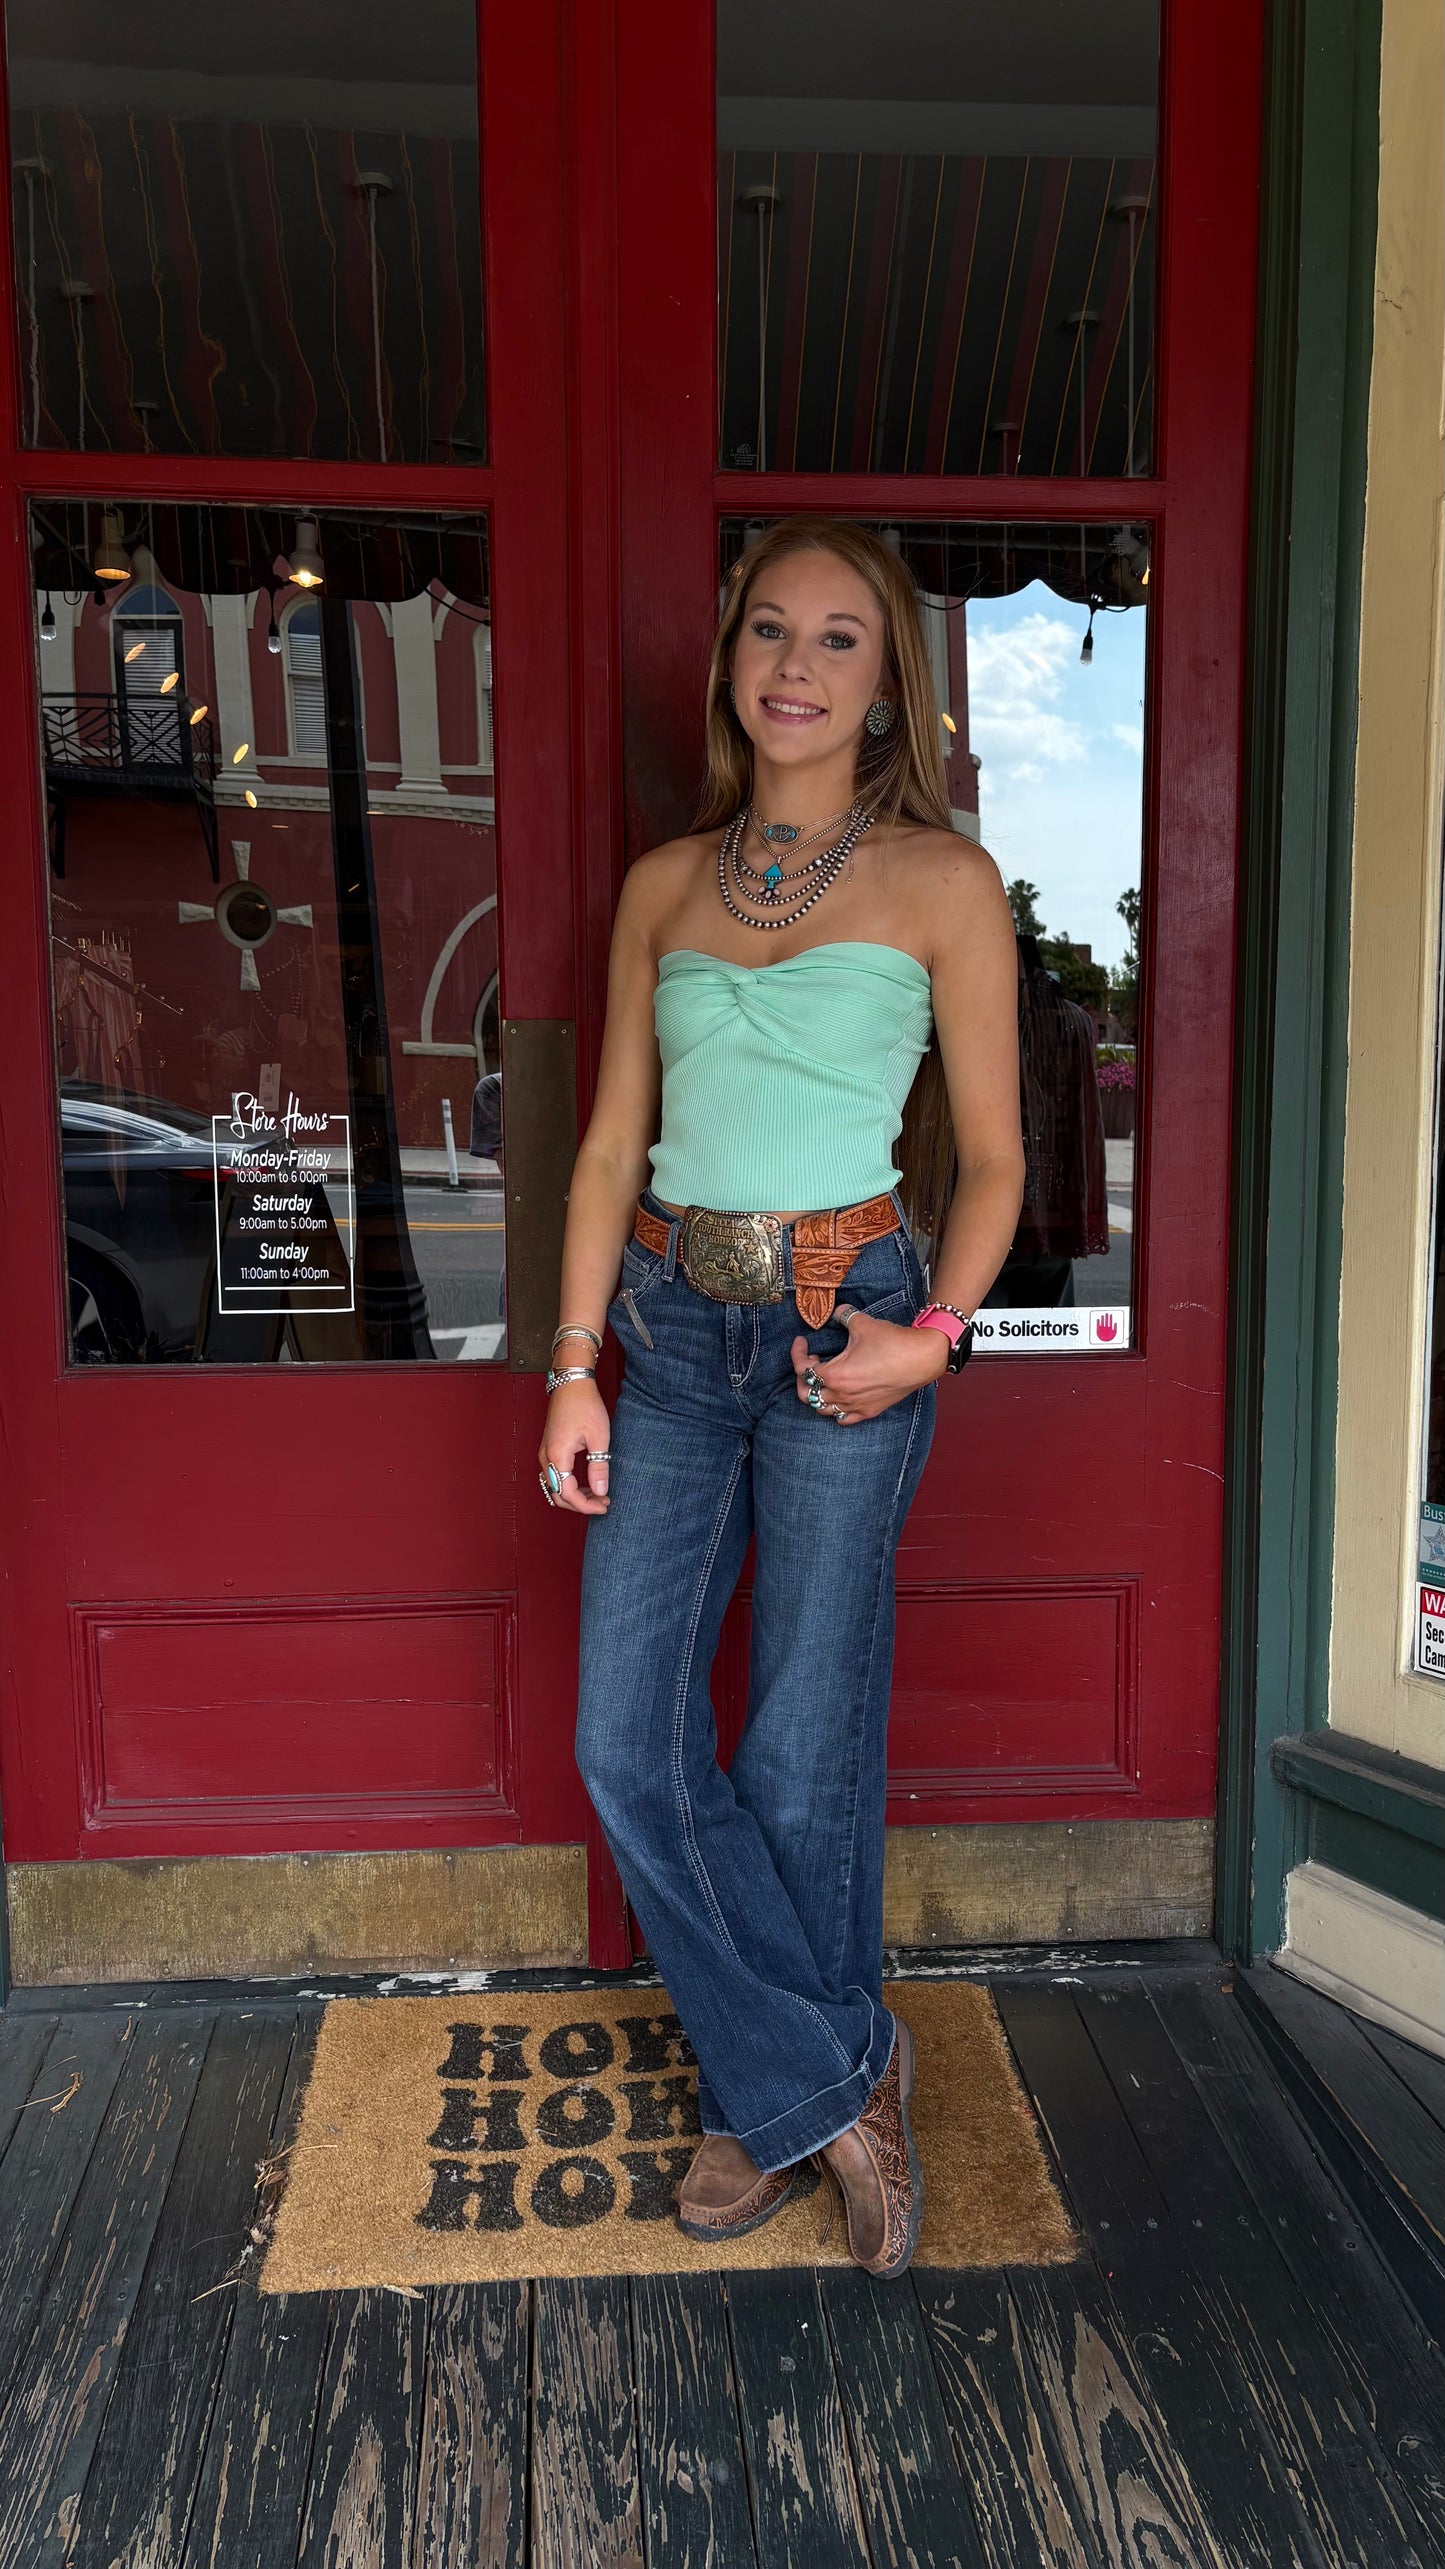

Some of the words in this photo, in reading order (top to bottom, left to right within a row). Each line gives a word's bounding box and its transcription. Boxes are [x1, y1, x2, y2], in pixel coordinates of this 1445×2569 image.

[230, 1092, 277, 1139] Store
[280, 1091, 329, 1139] Hours
[230, 1149, 331, 1170] Monday-Friday
[236, 1171, 276, 1183] 10:00am
[278, 1172, 288, 1183] to
[252, 1194, 313, 1214] Saturday
[239, 1217, 276, 1230] 9:00am
[278, 1218, 288, 1229] to
[259, 1242, 309, 1263] Sunday
[240, 1267, 277, 1280] 11:00am
[280, 1268, 290, 1280] to
[971, 1321, 994, 1337] No
[998, 1320, 1079, 1337] Solicitors
[1424, 1504, 1445, 1522] Bus
